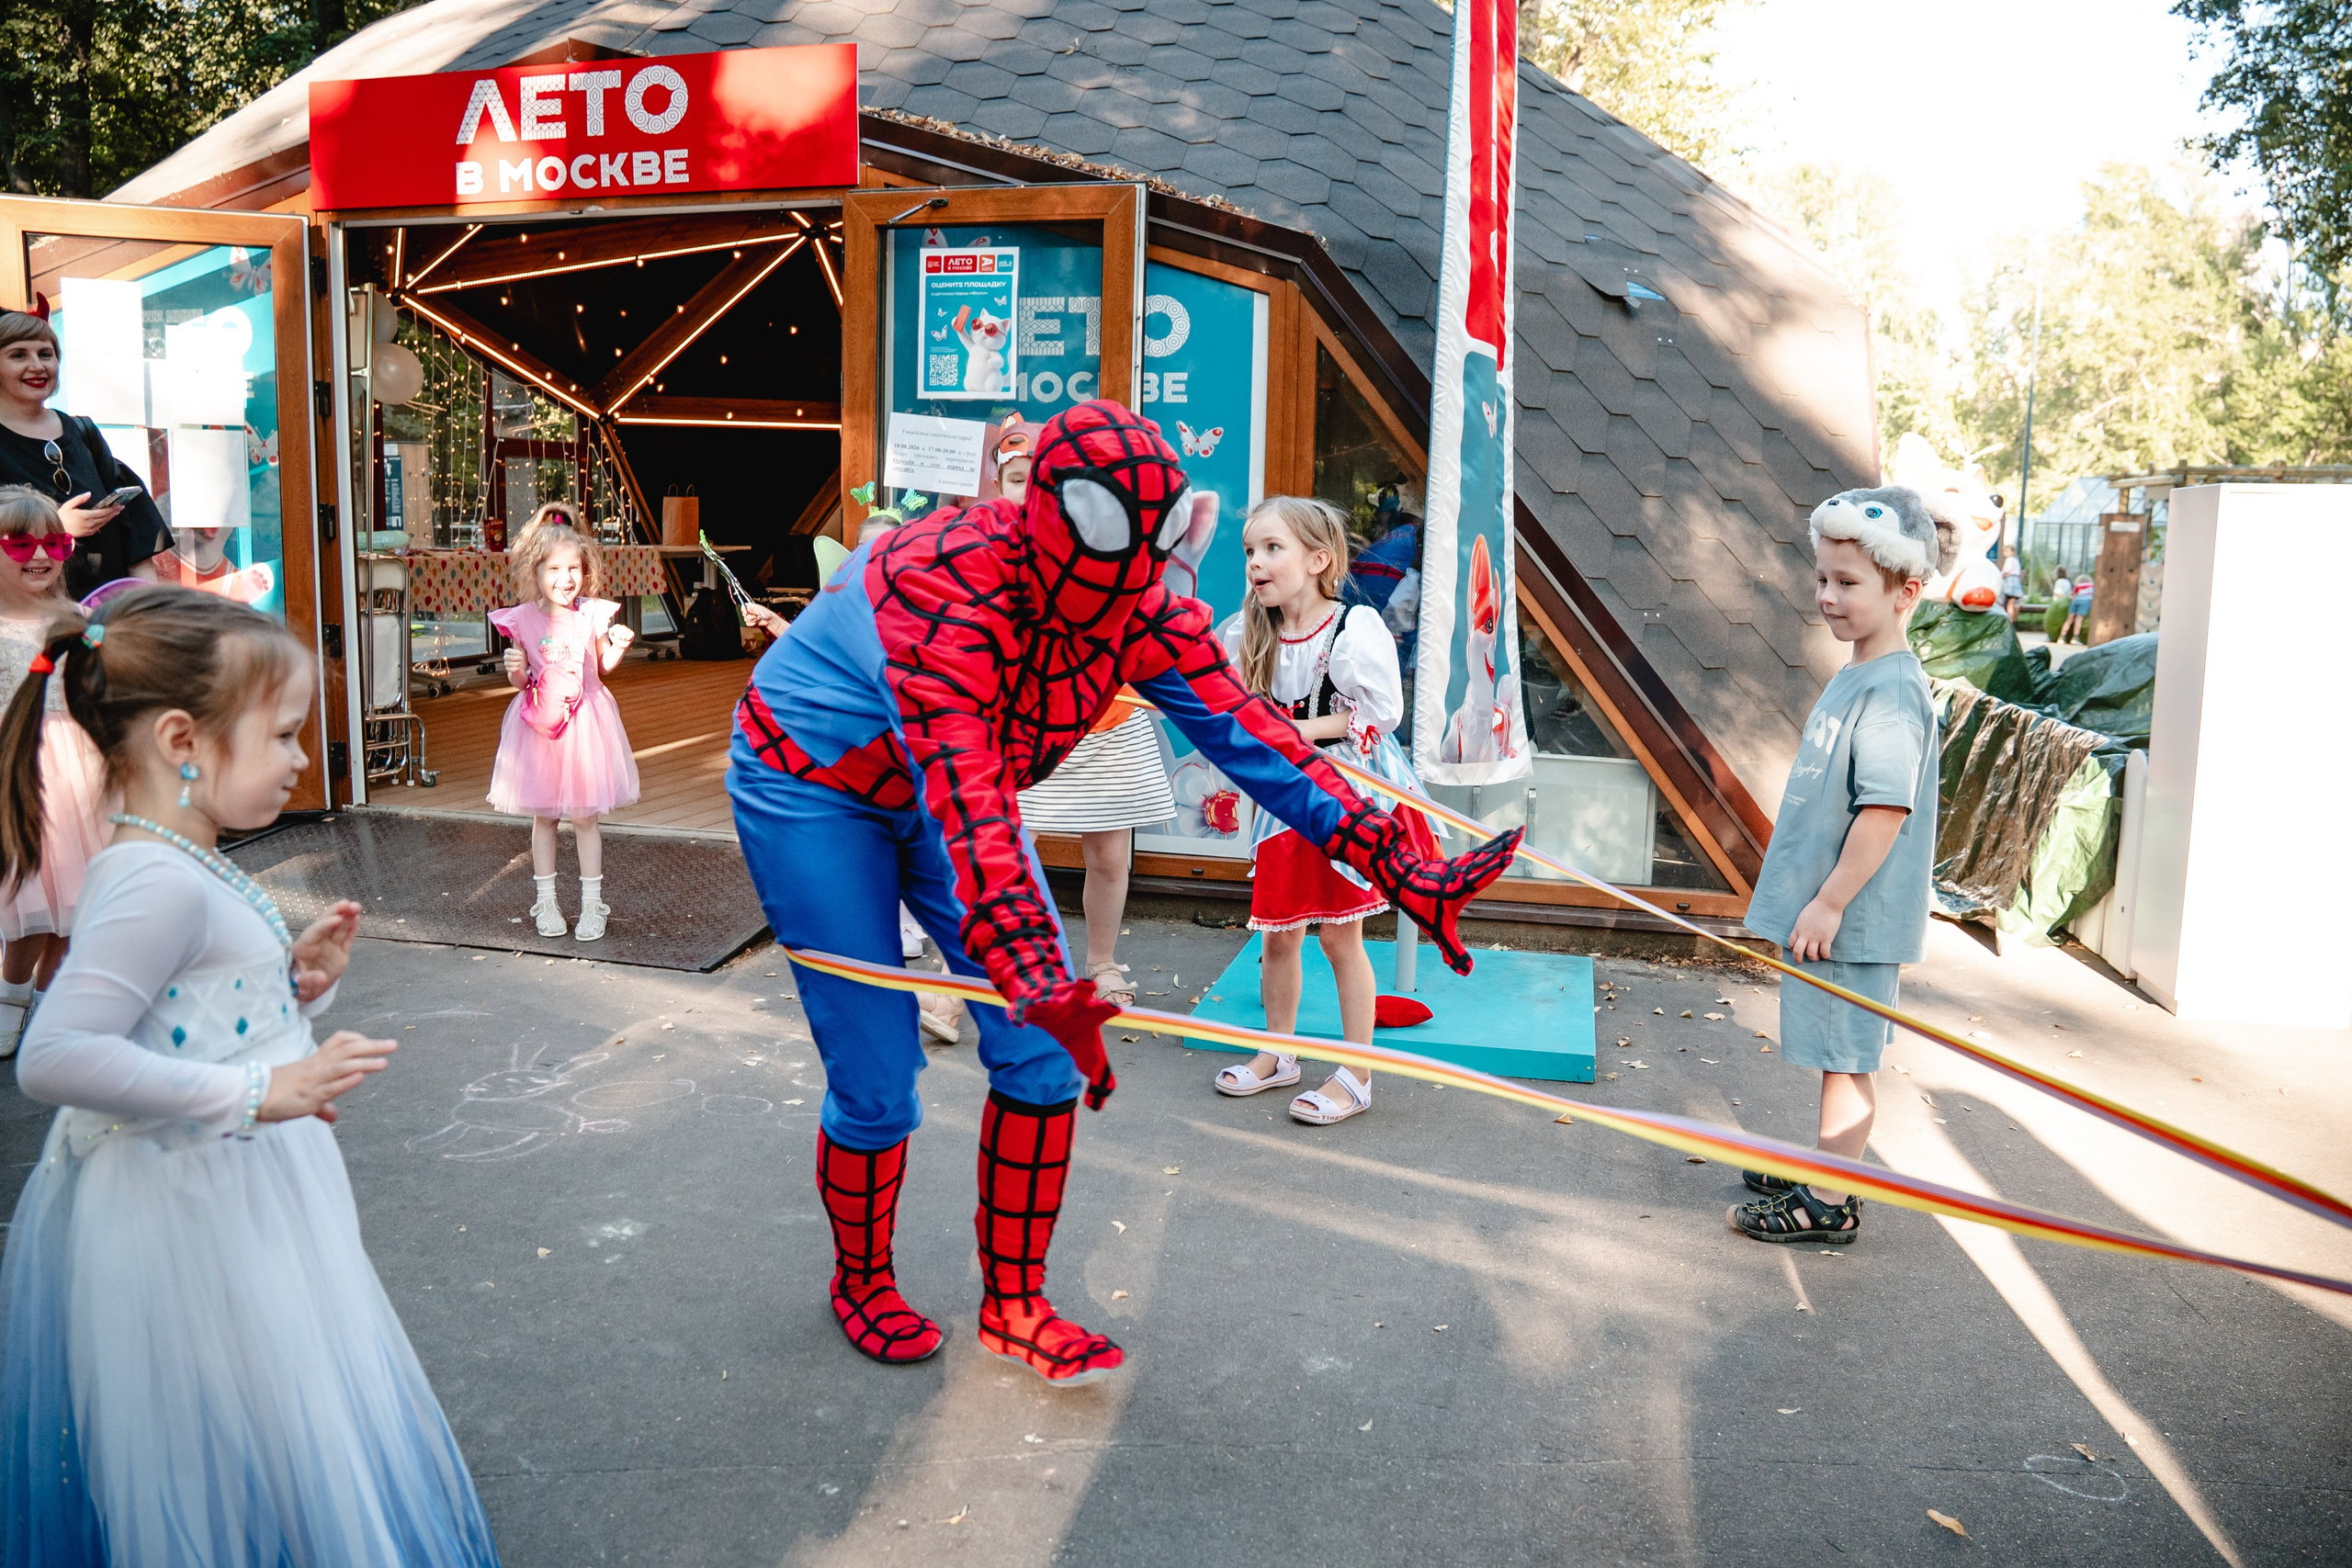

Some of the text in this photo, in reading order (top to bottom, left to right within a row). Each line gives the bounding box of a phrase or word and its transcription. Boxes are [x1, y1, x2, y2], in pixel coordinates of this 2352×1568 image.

[456, 64, 688, 145] ЛЕТО
[456, 149, 689, 196] В МОСКВЕ
[1018, 294, 1191, 358] ЕТО
